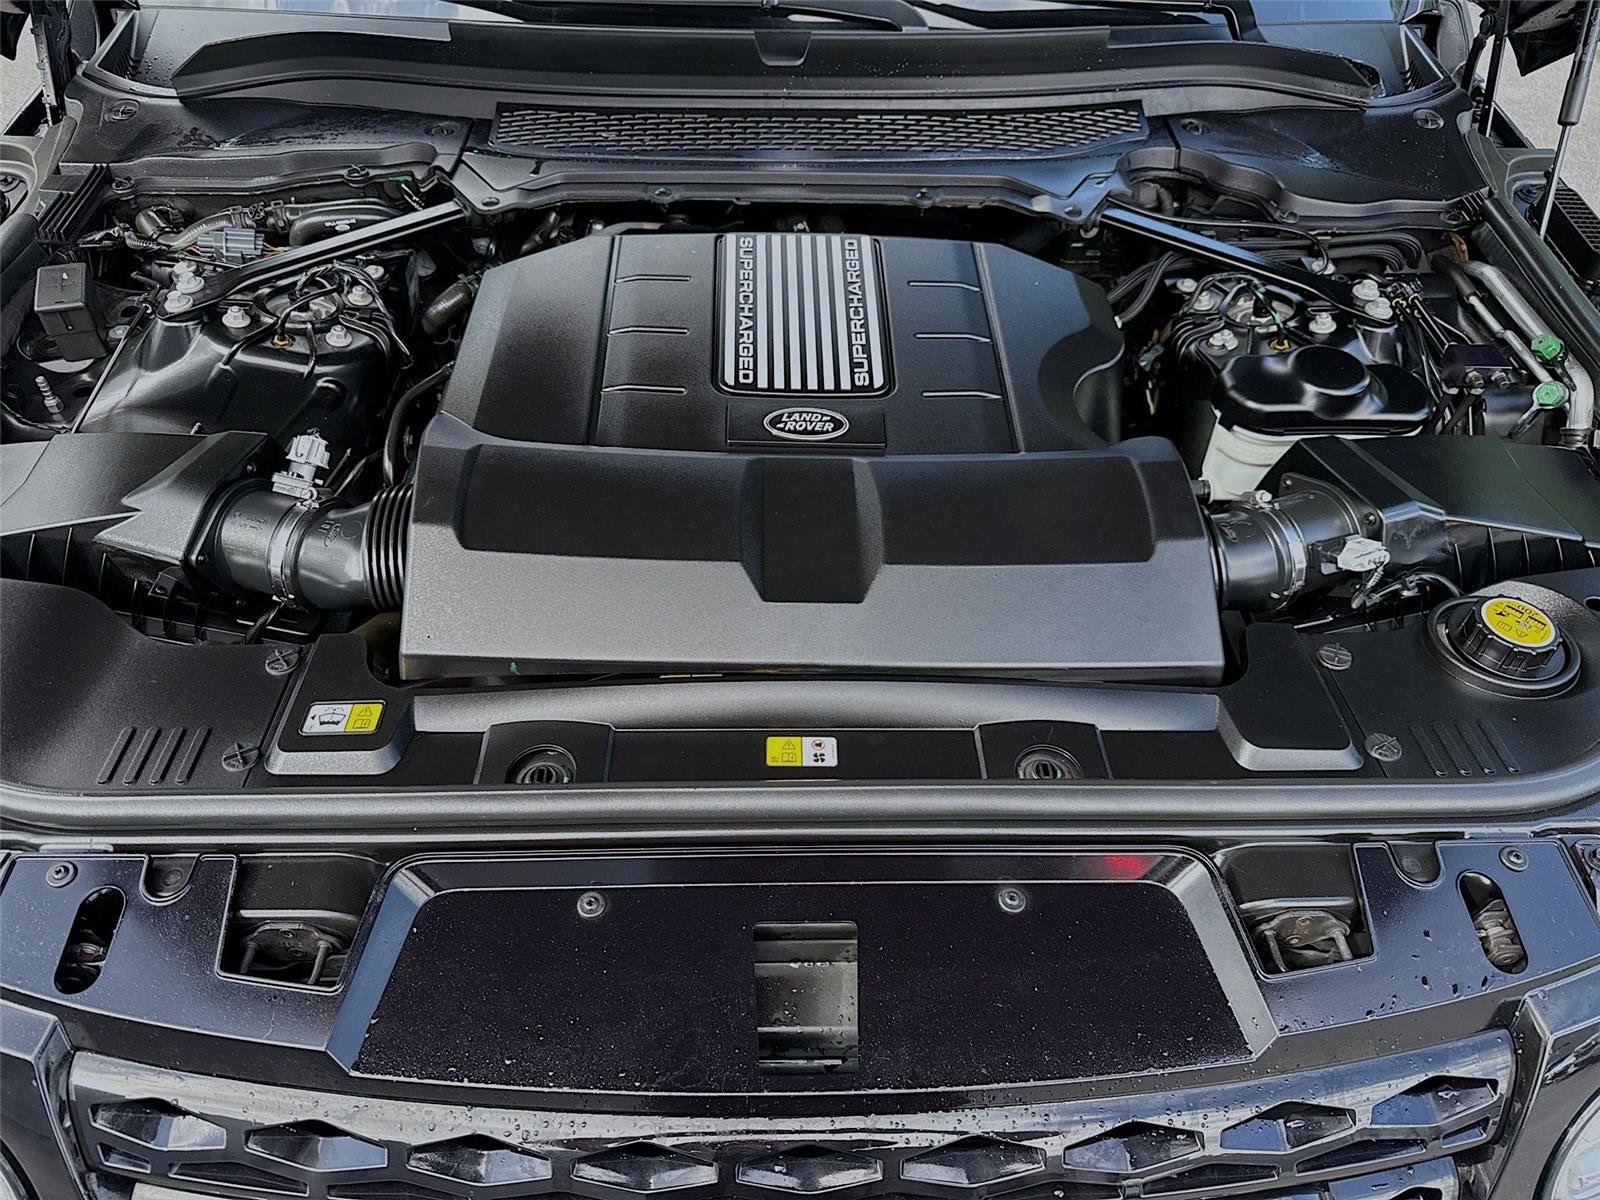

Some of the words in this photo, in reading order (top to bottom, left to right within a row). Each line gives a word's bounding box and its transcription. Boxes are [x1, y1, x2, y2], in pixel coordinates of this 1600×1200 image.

[738, 237, 754, 384] SUPERCHARGED
[844, 239, 870, 386] SUPERCHARGED
[781, 412, 822, 422] LAND
[784, 421, 835, 432] ROVER
